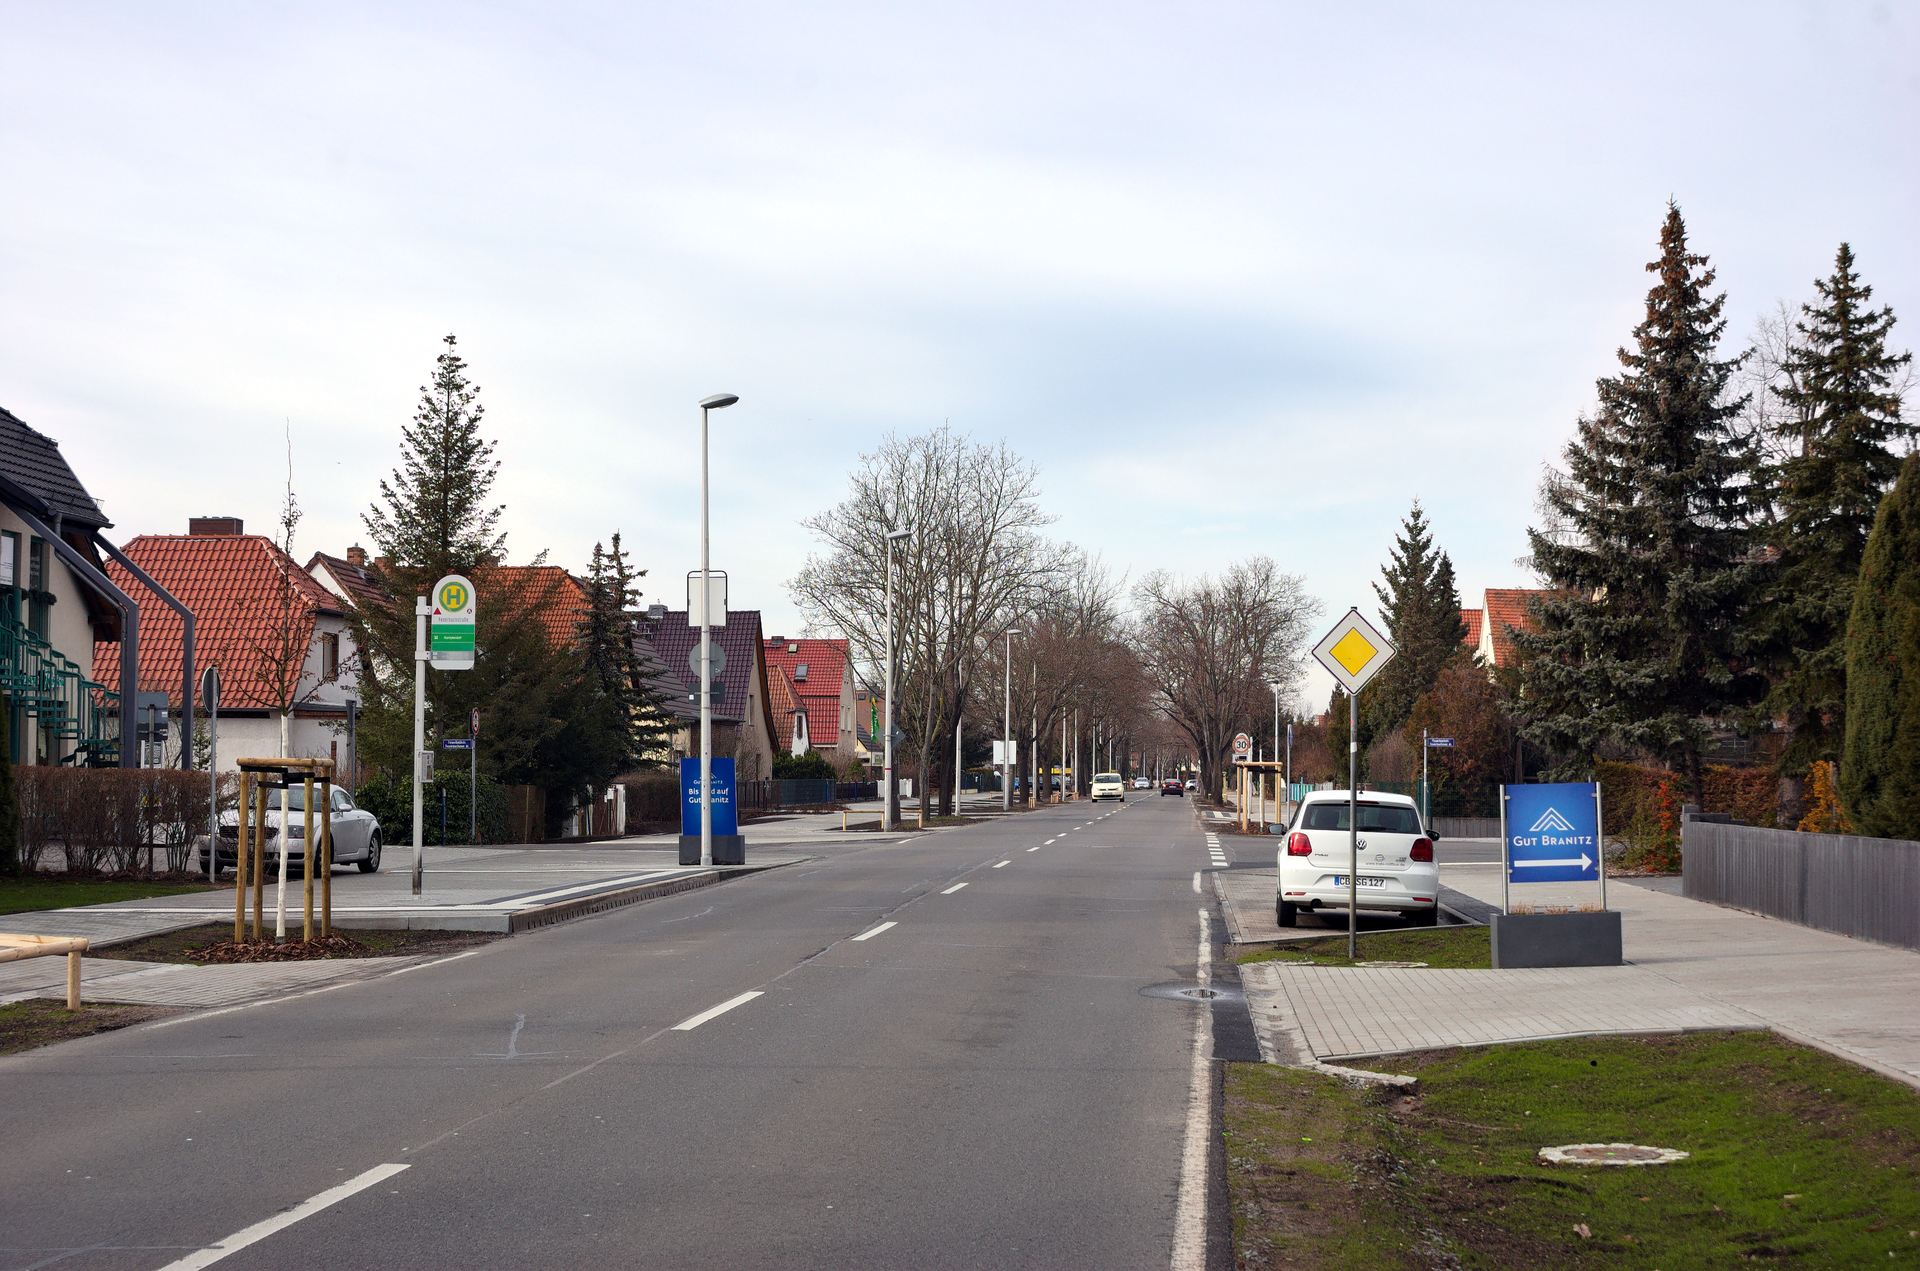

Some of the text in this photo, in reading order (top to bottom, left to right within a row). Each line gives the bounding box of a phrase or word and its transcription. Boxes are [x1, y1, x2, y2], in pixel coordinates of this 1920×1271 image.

[446, 588, 461, 606] H
[1236, 740, 1246, 749] 30
[716, 787, 729, 796] auf
[1339, 877, 1384, 887] CB SG 127
